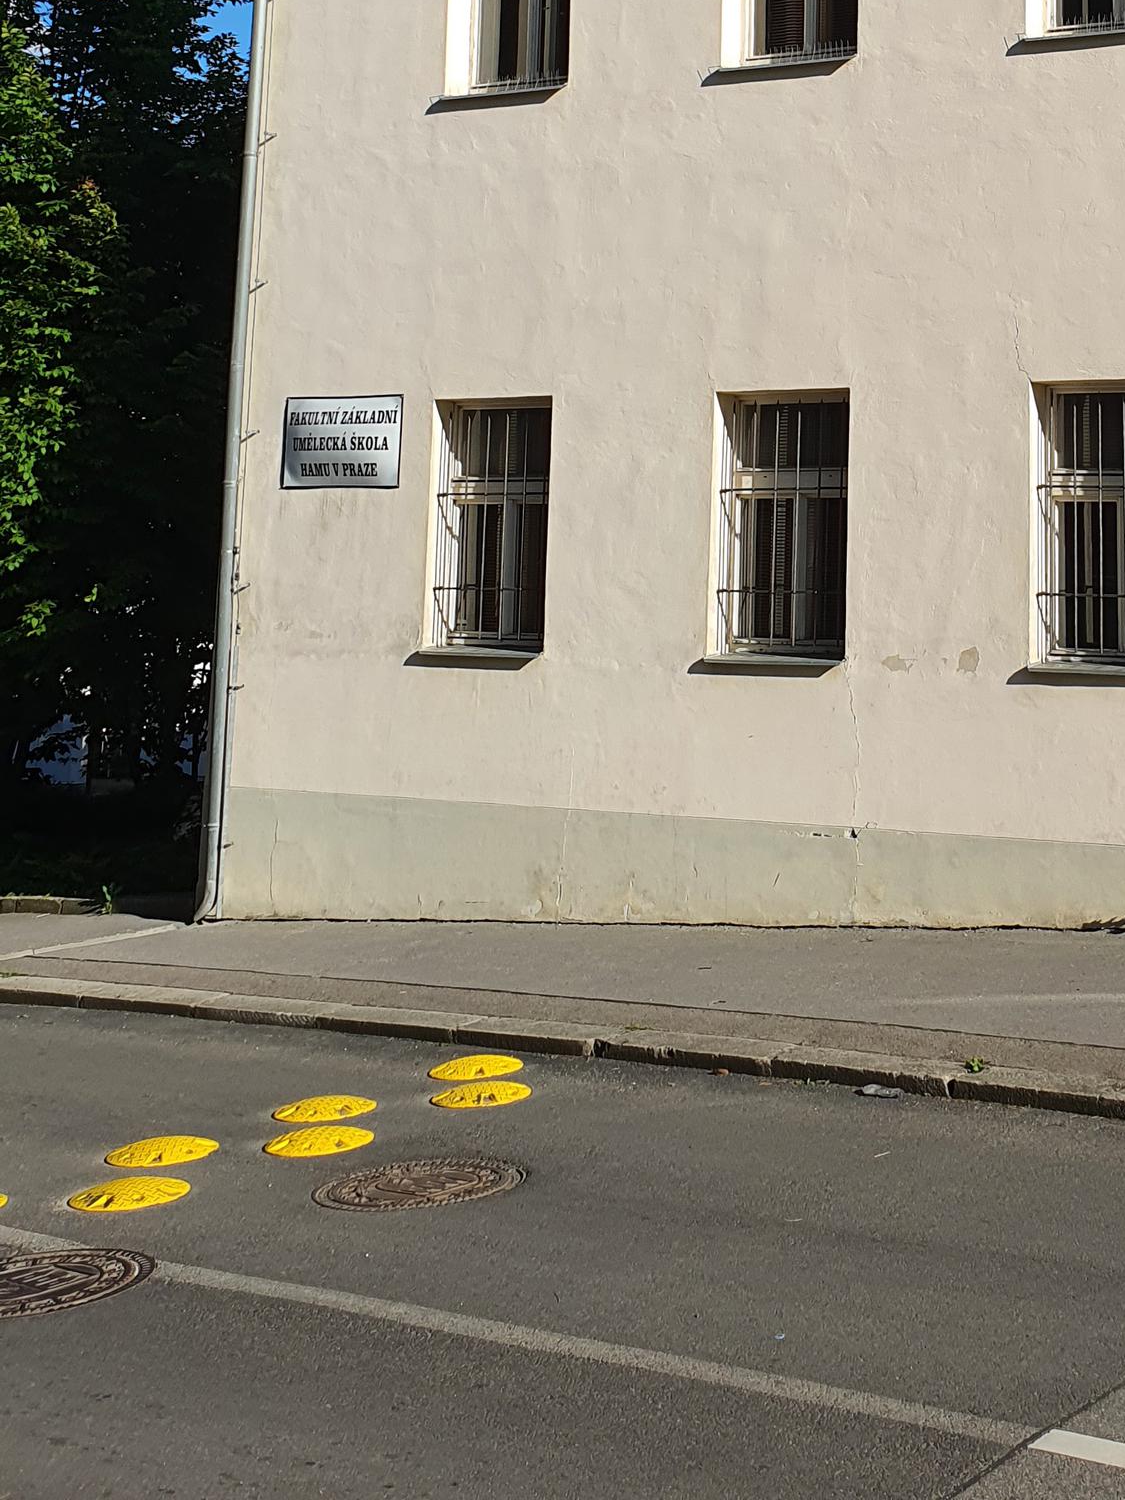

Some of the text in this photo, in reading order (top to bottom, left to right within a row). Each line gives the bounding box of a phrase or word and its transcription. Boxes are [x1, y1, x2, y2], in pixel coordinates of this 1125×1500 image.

[289, 404, 398, 426] FAKULTNÍ ZÁKLADNÍ
[293, 431, 389, 452] UMĚLECKÁ ŠKOLA
[300, 462, 378, 477] HAMU V PRAZE
